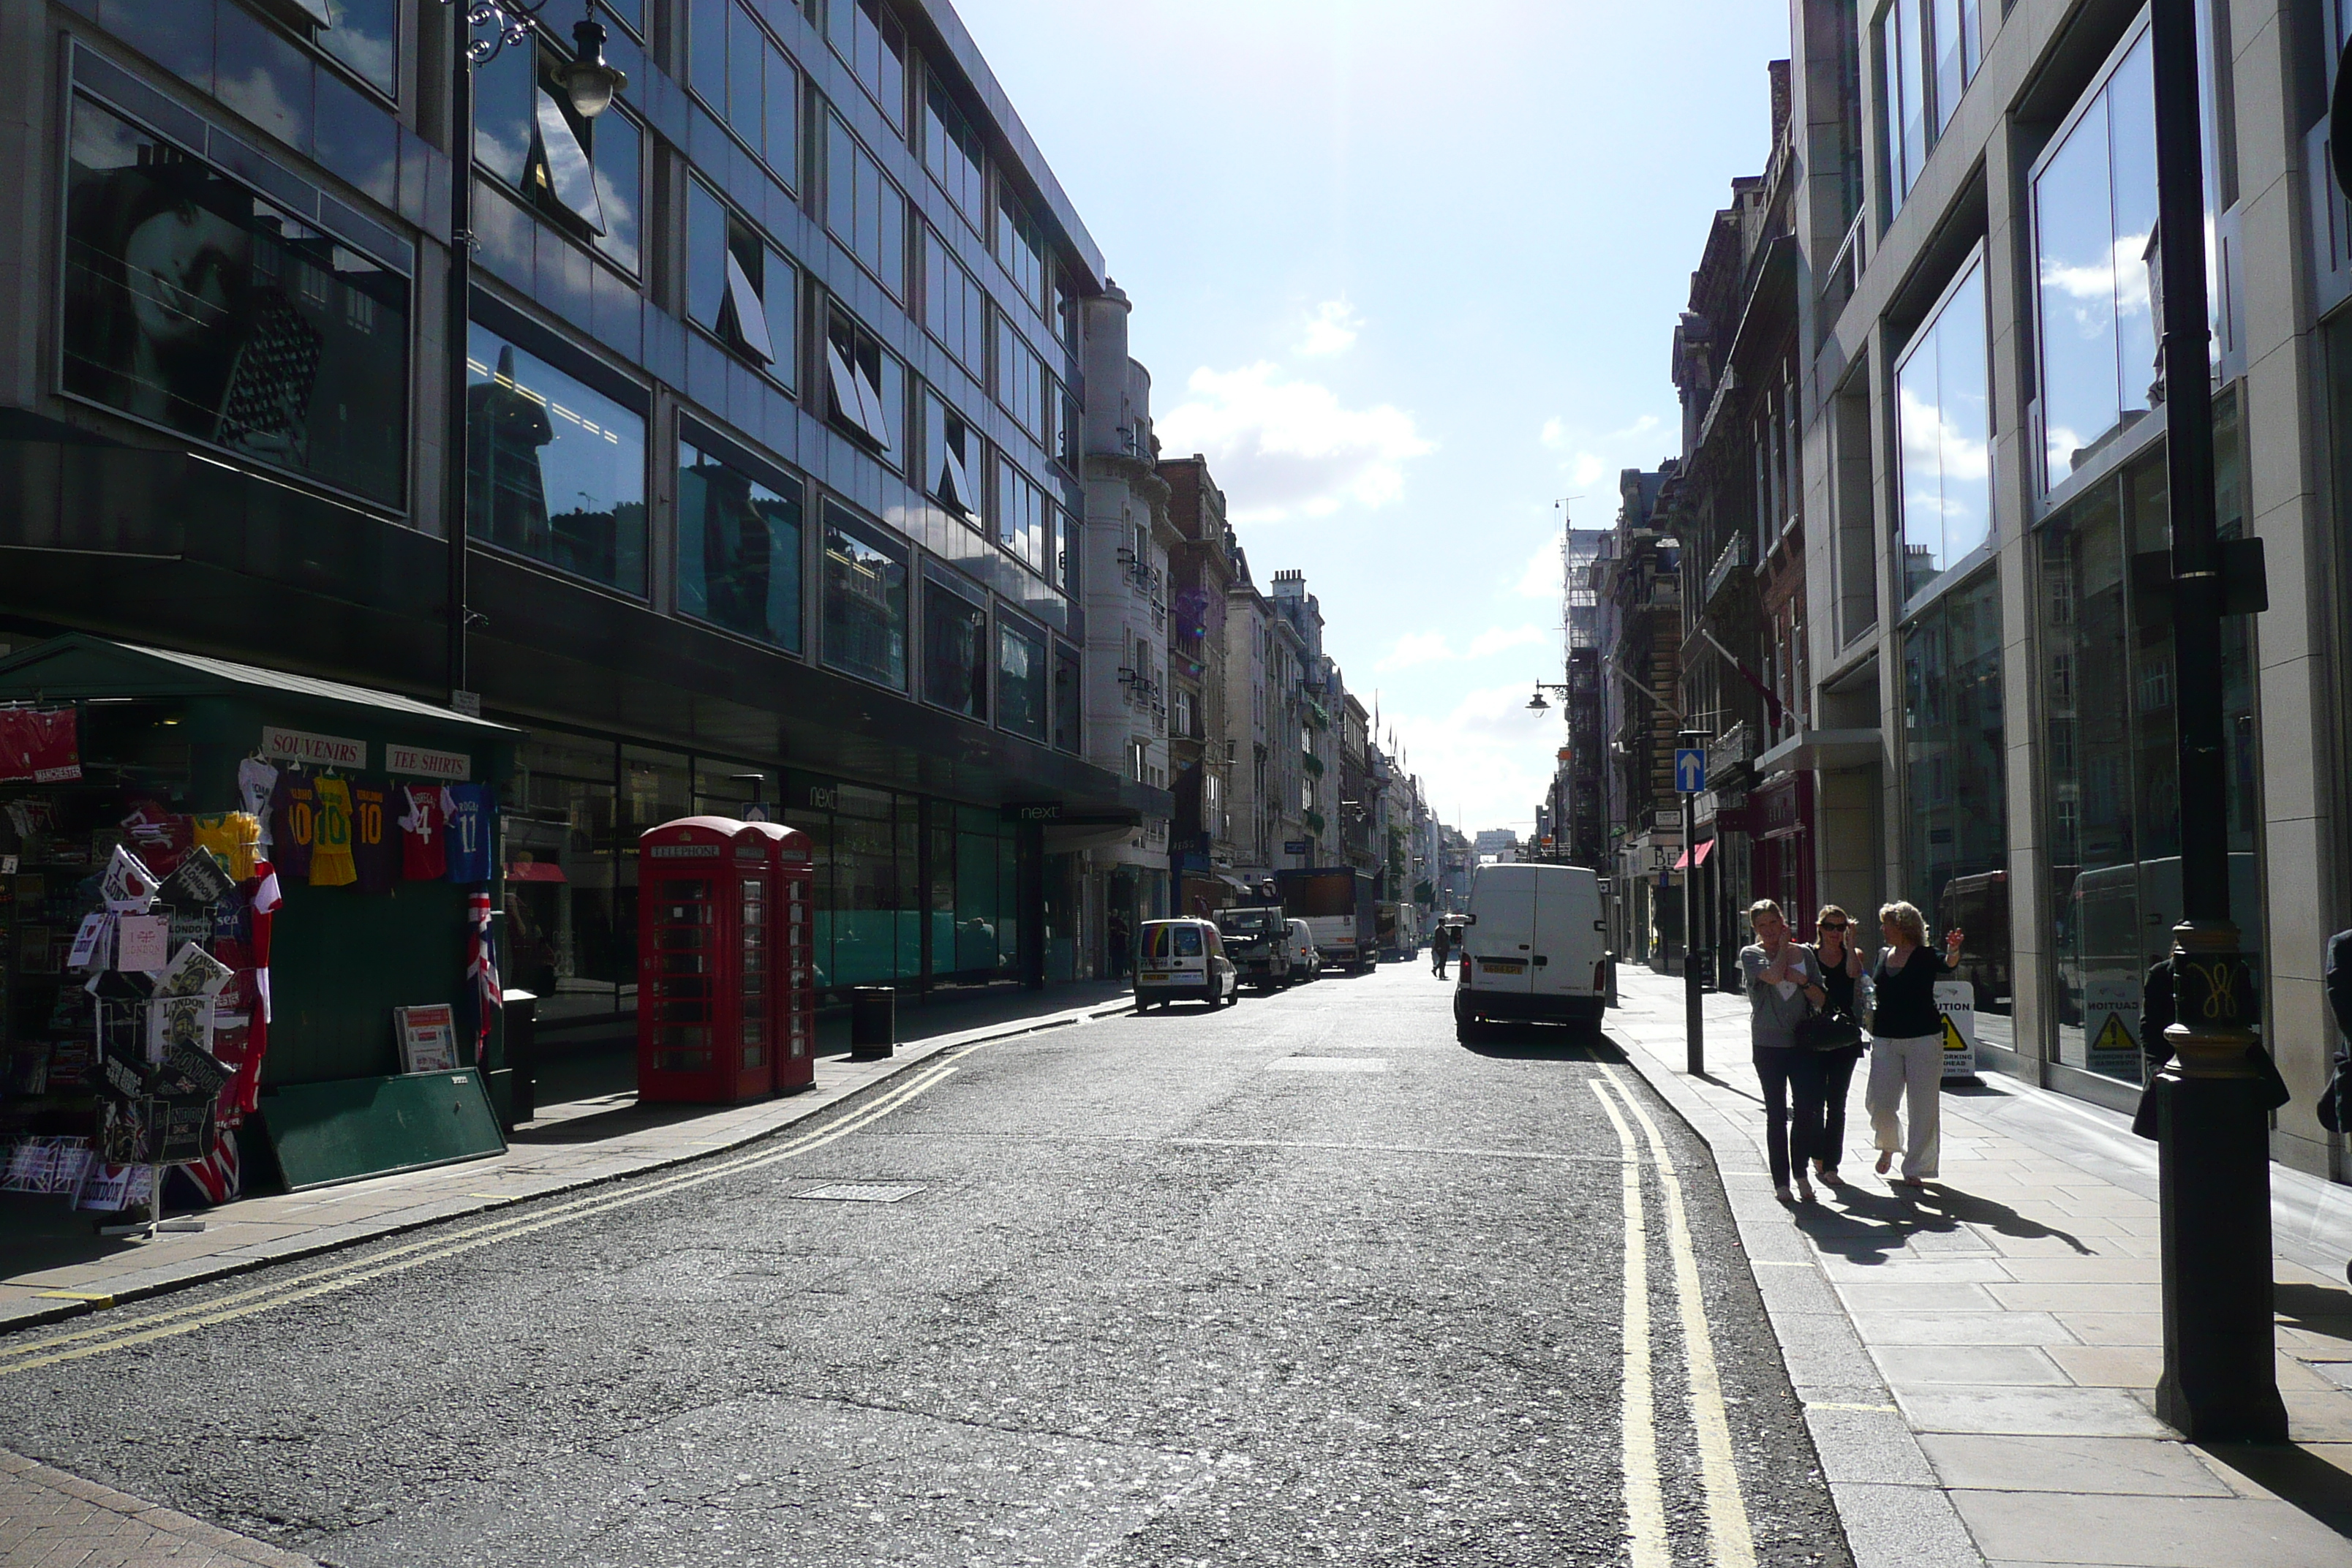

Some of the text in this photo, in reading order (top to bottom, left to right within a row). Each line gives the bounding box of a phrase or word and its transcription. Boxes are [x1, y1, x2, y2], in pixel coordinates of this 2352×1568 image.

[272, 735, 358, 762] SOUVENIRS
[394, 751, 464, 774] TEE SHIRTS
[37, 767, 80, 780] MANCHESTER
[810, 786, 837, 810] next
[1021, 806, 1060, 819] next
[359, 803, 382, 845] 10
[416, 805, 432, 845] 4
[460, 814, 477, 853] 11
[655, 847, 716, 856] TELEPHONE
[1654, 851, 1682, 866] BE
[114, 860, 125, 882] I
[184, 867, 214, 900] LONDON
[169, 924, 211, 934] LONDON
[216, 914, 238, 926] sea
[130, 932, 135, 943] I
[124, 944, 159, 956] LONDON
[184, 951, 222, 981] LONDON
[163, 999, 206, 1018] LONDON
[1935, 1003, 1970, 1011] UTION
[166, 1047, 225, 1093] LONDON
[155, 1107, 205, 1129] LONDON
[83, 1181, 123, 1202] LONDON
